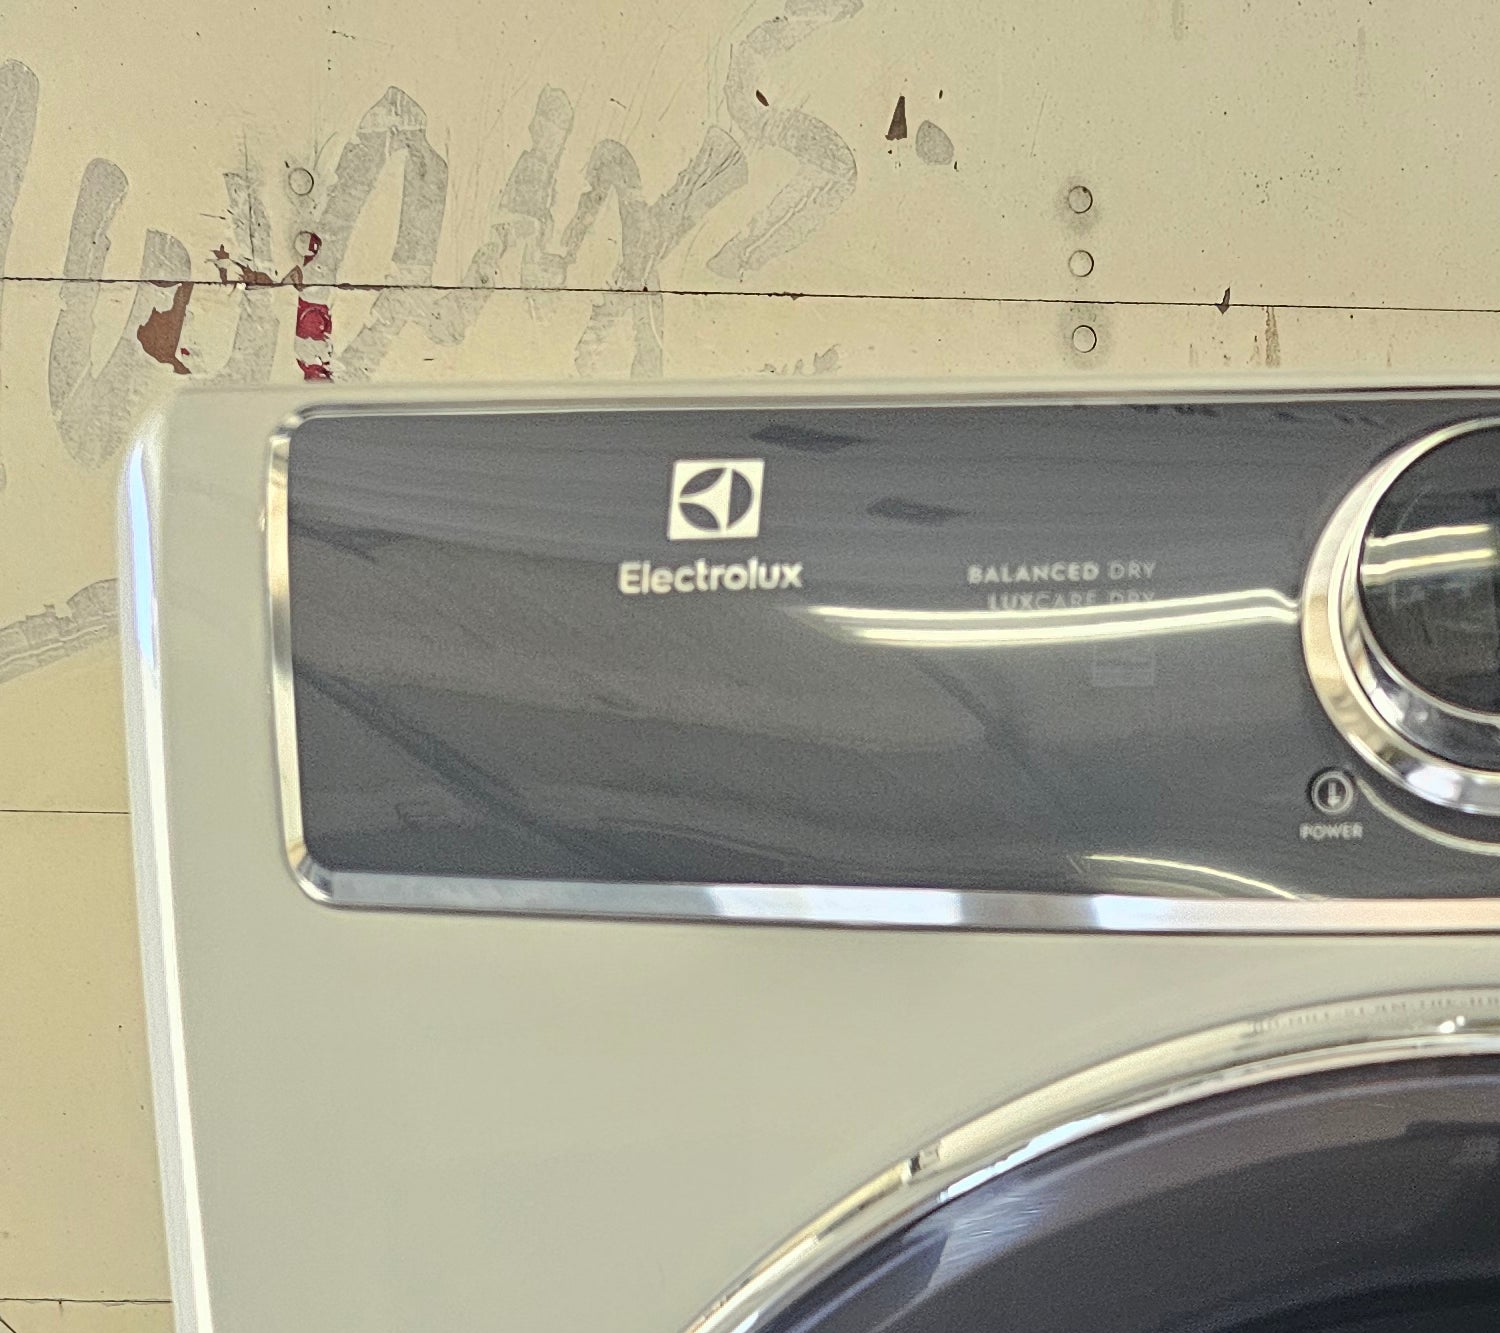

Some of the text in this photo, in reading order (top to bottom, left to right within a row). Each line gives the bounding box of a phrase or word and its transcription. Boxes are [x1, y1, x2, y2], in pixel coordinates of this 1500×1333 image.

[619, 557, 802, 595] Electrolux
[967, 560, 1156, 584] BALANCED DRY
[1300, 823, 1362, 839] POWER
